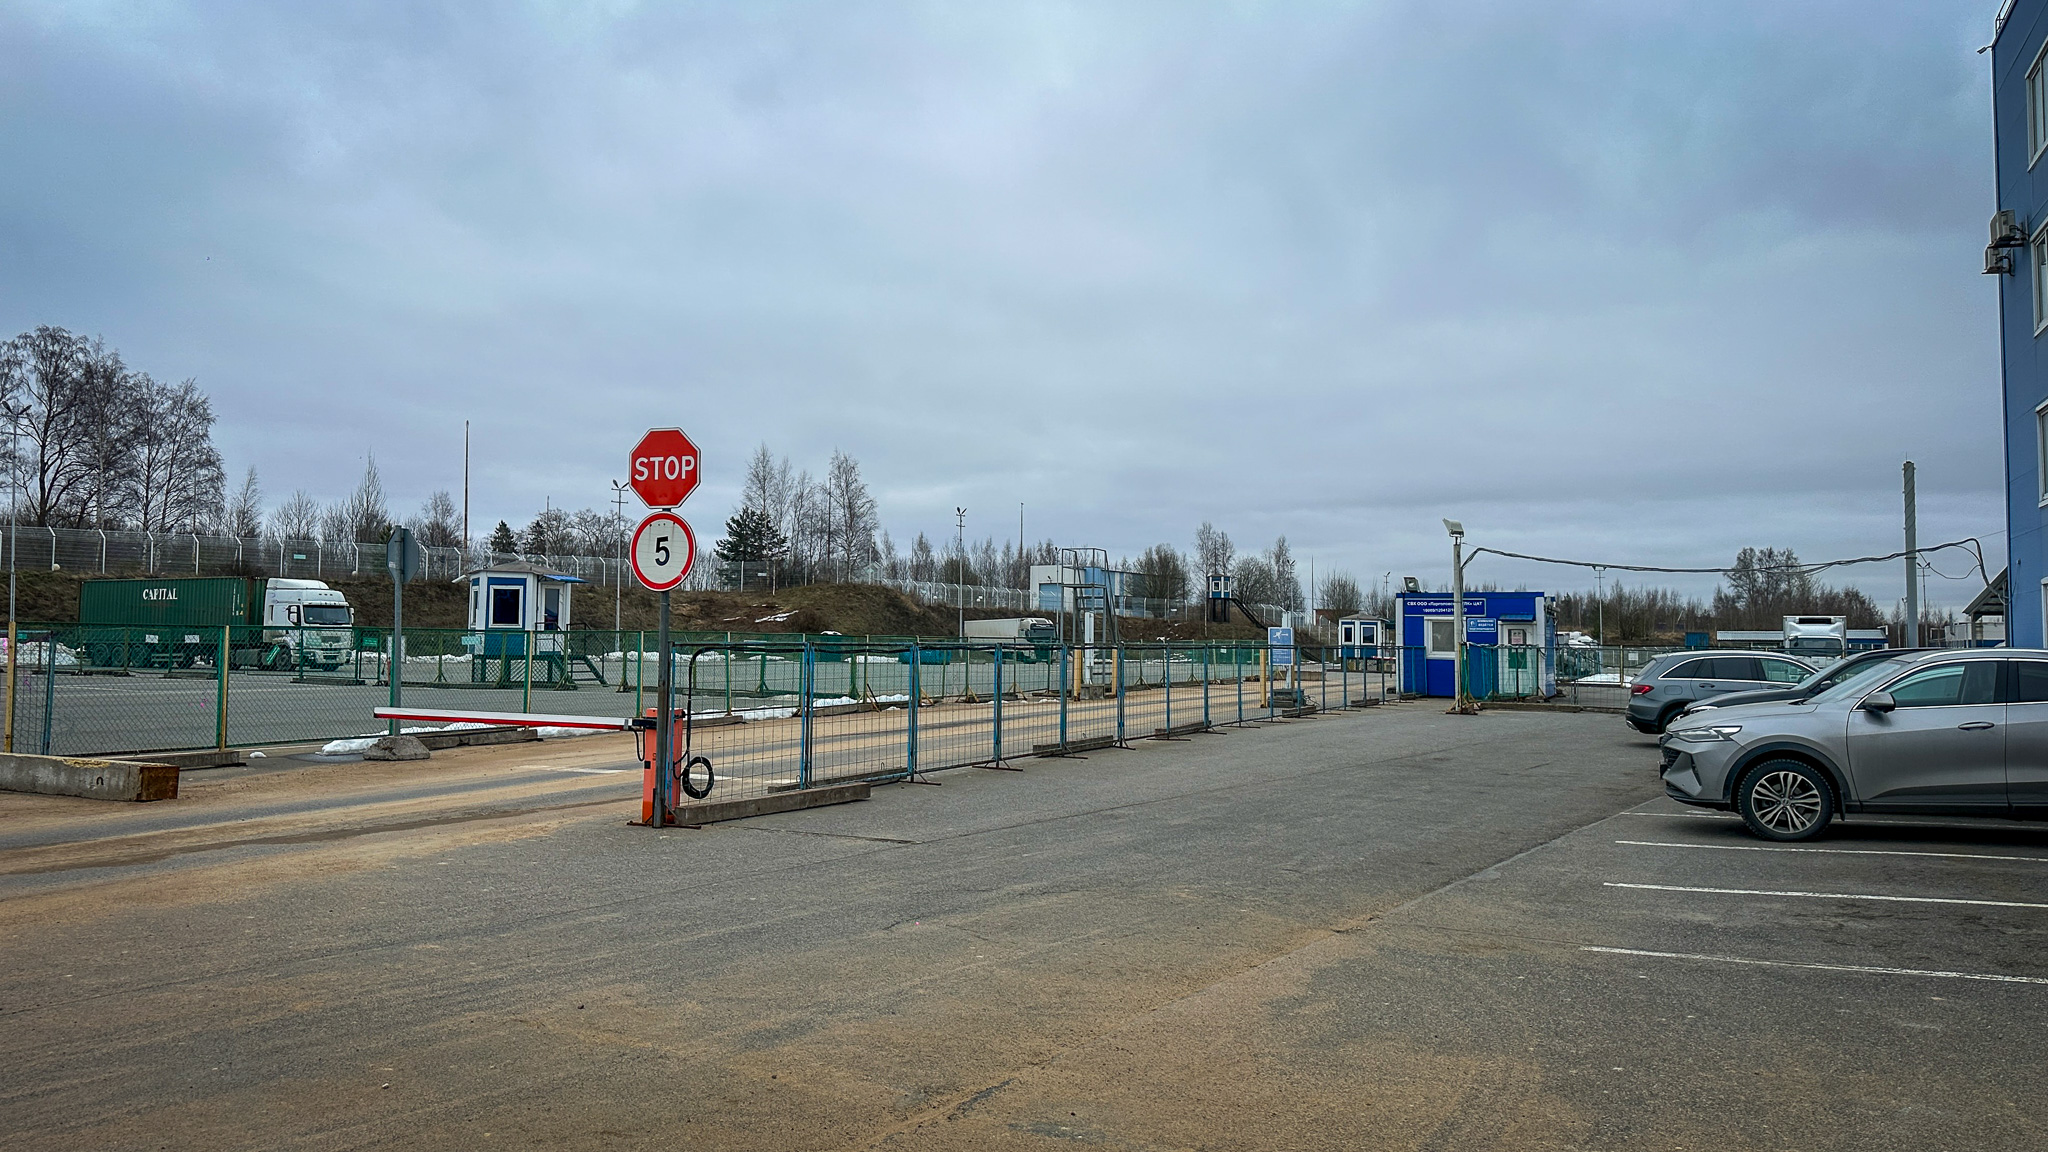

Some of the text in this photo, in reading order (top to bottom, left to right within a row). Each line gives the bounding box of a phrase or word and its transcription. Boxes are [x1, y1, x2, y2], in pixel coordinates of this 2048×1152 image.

[634, 455, 695, 481] STOP
[654, 535, 671, 566] 5
[142, 588, 178, 600] CAPITAL
